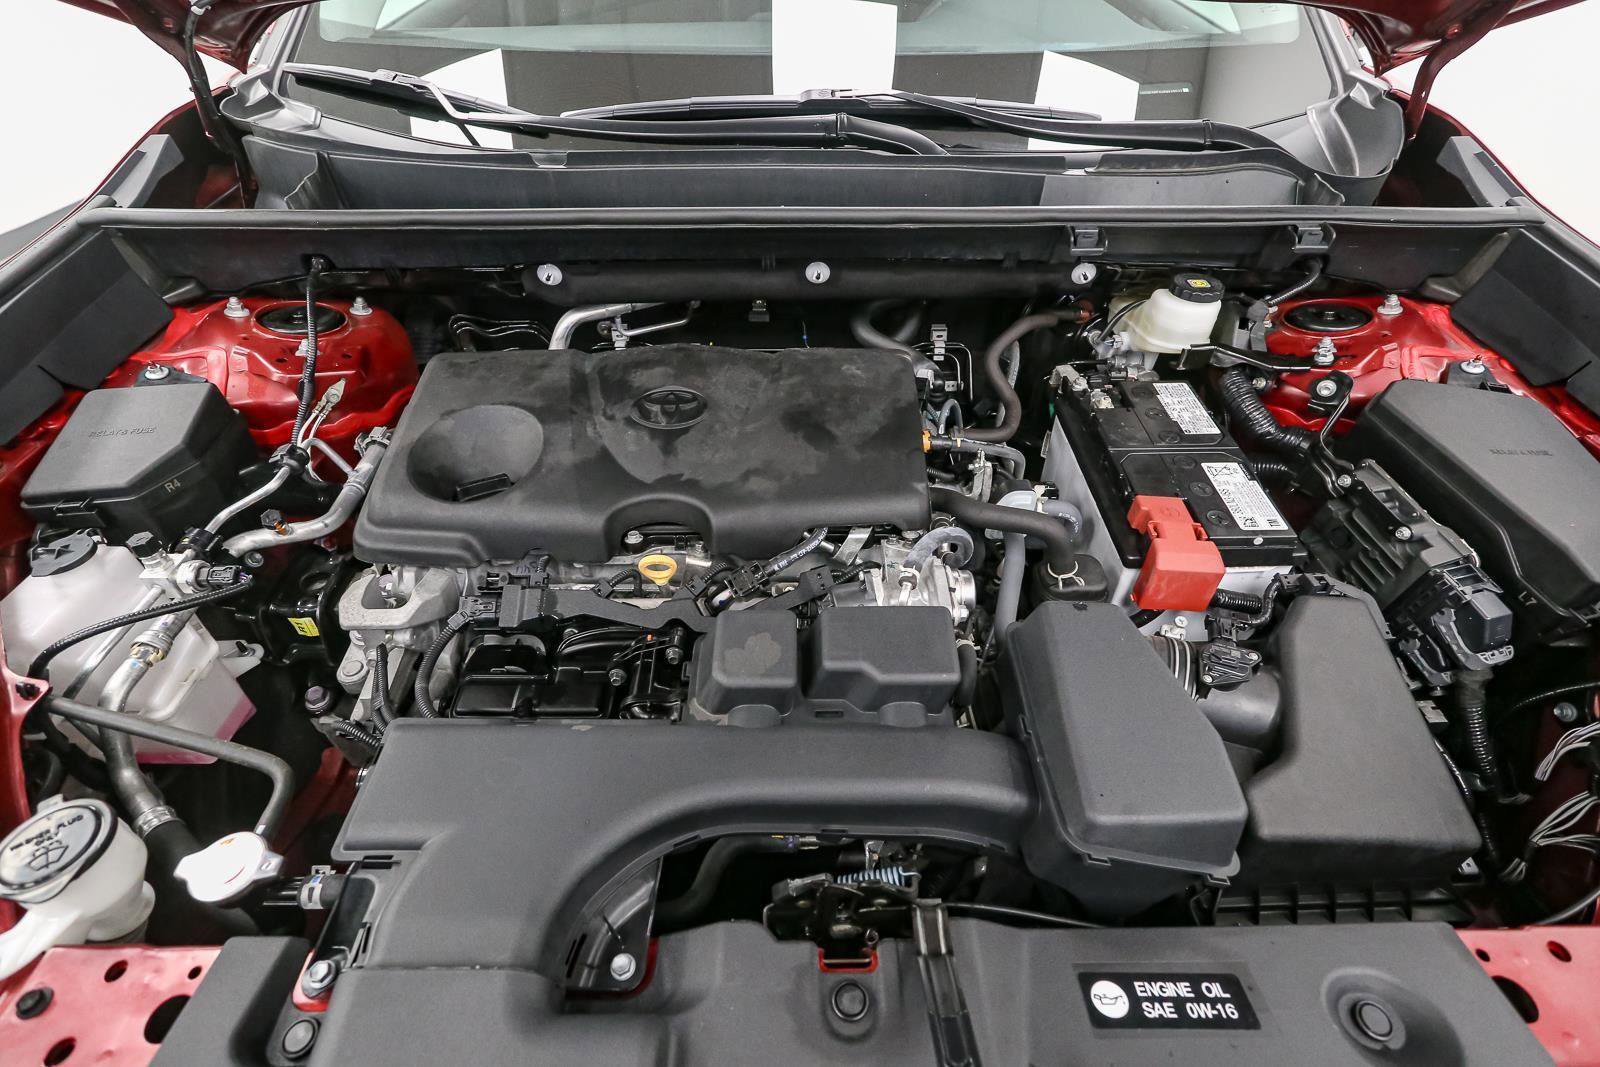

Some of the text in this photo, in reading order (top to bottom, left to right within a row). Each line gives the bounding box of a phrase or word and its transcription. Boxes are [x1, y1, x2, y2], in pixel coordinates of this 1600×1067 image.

[130, 426, 157, 435] FUSE
[164, 479, 180, 493] R4
[1133, 981, 1231, 999] ENGINE OIL
[1142, 1002, 1239, 1019] SAE 0W-16
